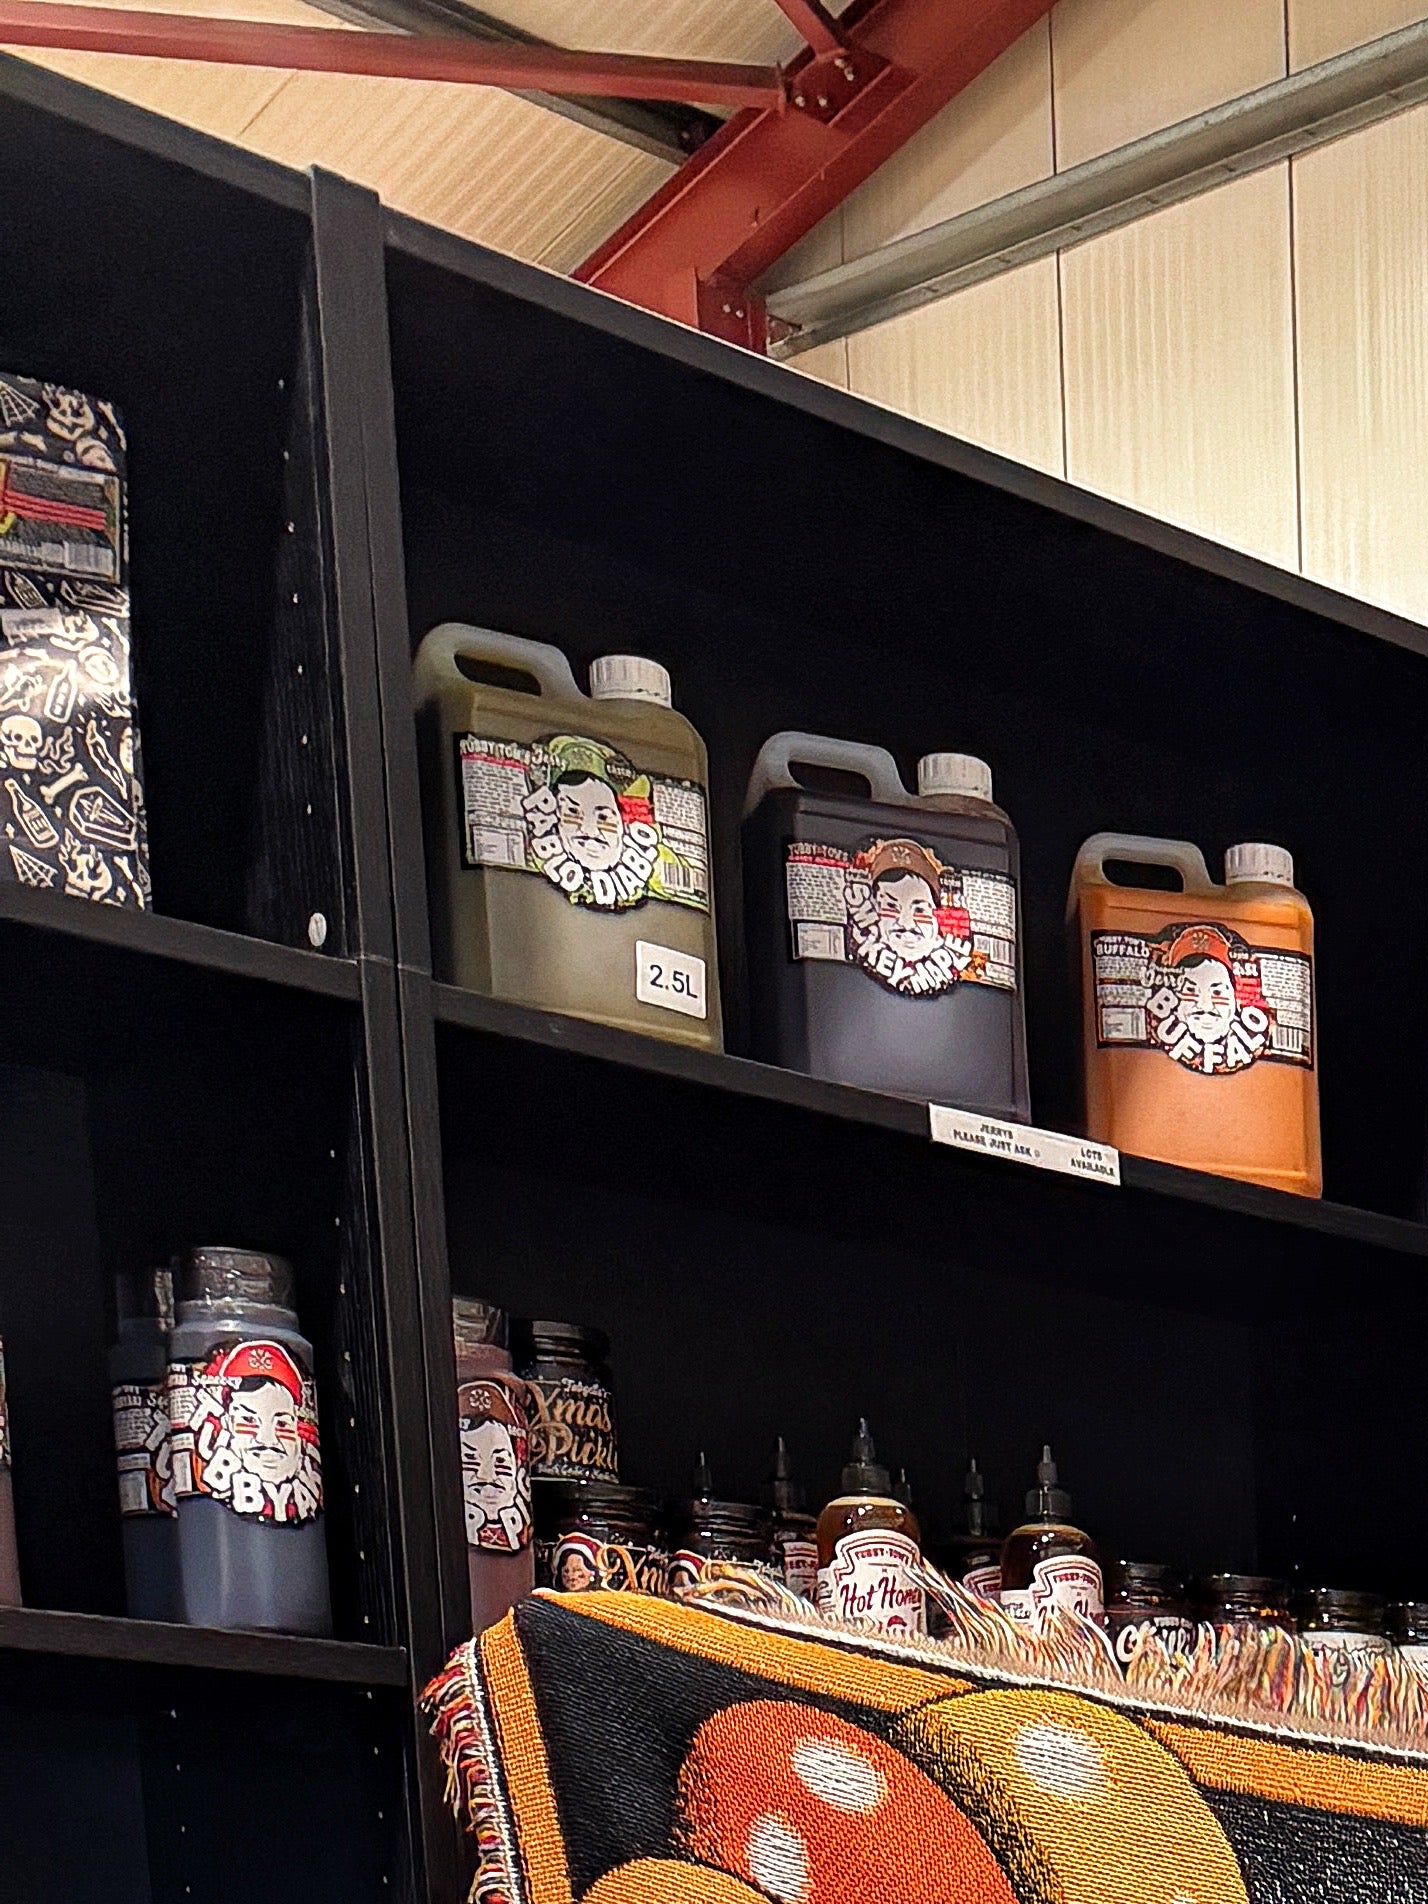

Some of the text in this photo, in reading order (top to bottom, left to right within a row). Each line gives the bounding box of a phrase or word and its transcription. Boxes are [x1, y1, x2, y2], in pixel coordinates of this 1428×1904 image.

[521, 785, 585, 892] PABLO
[591, 822, 658, 905] DIABLO
[843, 882, 915, 986] SMOKEY
[909, 933, 972, 993] MAPLE
[1096, 944, 1150, 957] BUFFALO
[649, 964, 698, 1000] 2.5L
[1147, 987, 1269, 1074] BUFFALO
[953, 1129, 1032, 1157] PLEASE JUST ASK
[1080, 1147, 1102, 1161] LOTS
[1070, 1158, 1115, 1177] AVAILABLE
[530, 1380, 611, 1433] Xmas
[190, 1387, 293, 1522] TUBBY
[840, 1581, 874, 1617] Hot
